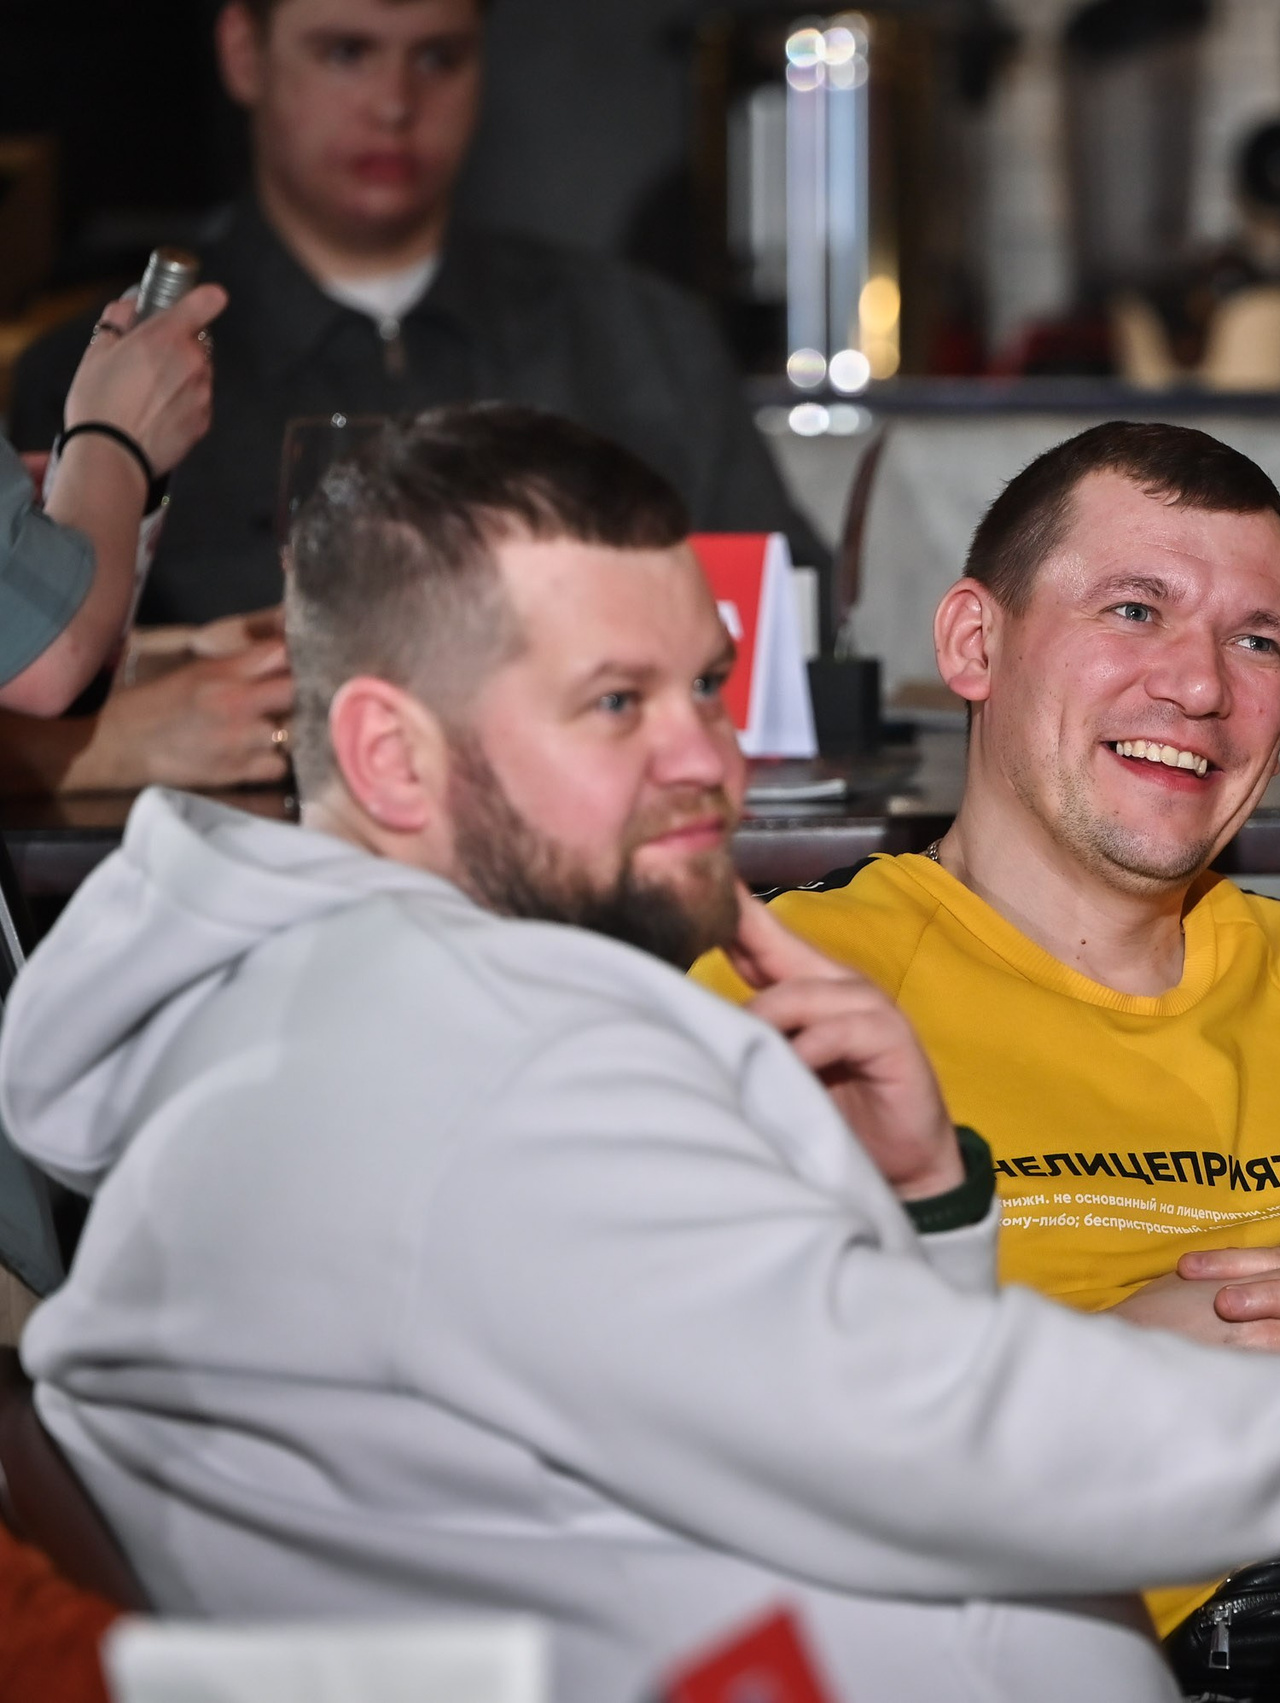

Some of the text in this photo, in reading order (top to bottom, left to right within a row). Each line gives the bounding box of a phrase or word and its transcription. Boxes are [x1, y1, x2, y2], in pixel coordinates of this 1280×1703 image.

[1000, 1194, 1050, 1208] нижн.
[1054, 1192, 1071, 1204] не
[1075, 1192, 1157, 1211] основанный
[1160, 1203, 1175, 1215] на
[1176, 1205, 1266, 1222] лицеприятии,
[999, 1213, 1079, 1229] ому-либо;
[1084, 1213, 1207, 1234] беспристрастный,
